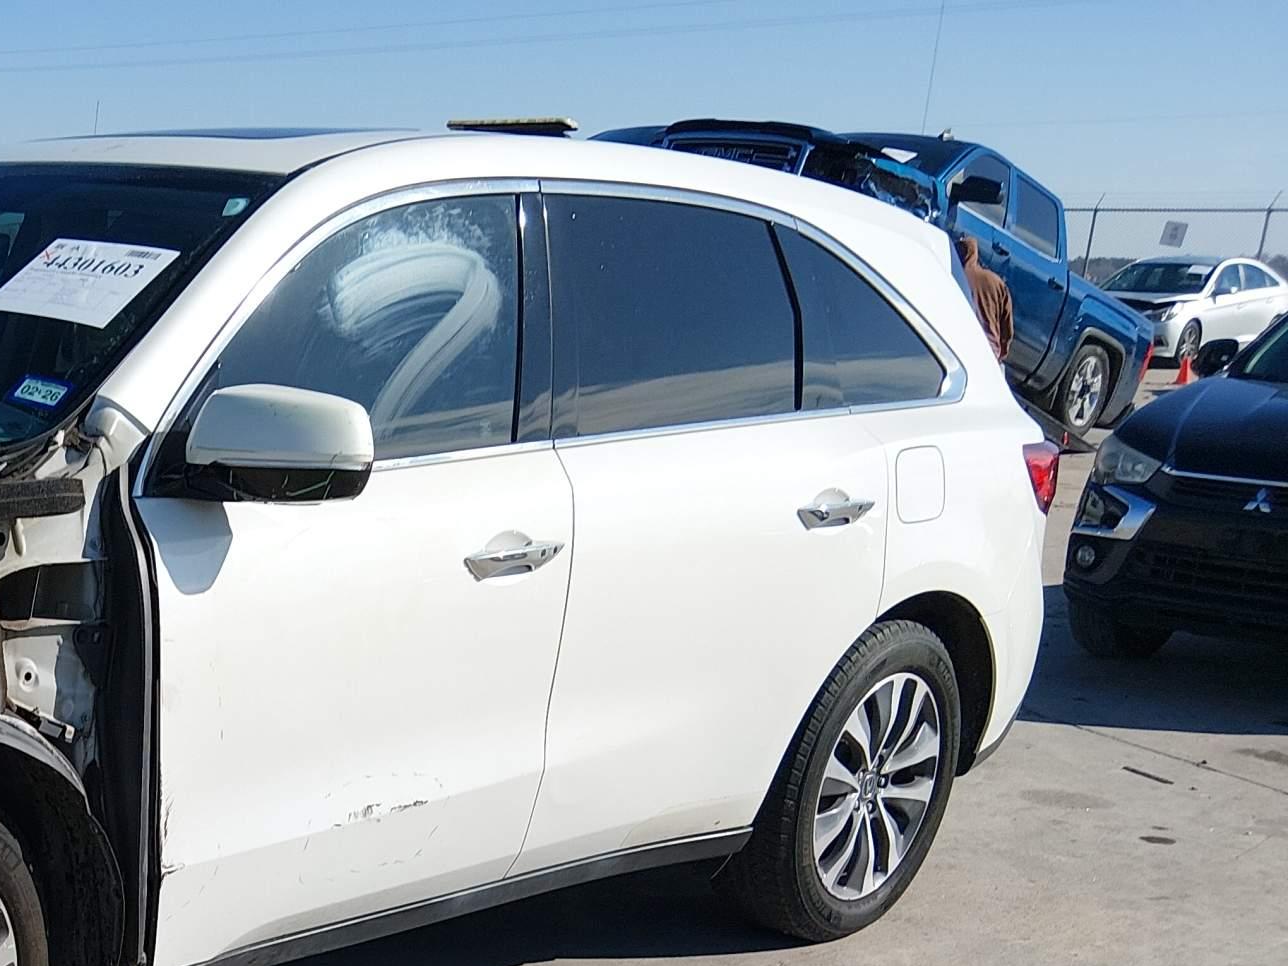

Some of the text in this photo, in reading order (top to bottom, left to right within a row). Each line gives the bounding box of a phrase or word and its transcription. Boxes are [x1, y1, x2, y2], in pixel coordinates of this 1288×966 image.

[43, 255, 145, 279] 44301603
[20, 384, 39, 397] 02
[41, 389, 61, 402] 26
